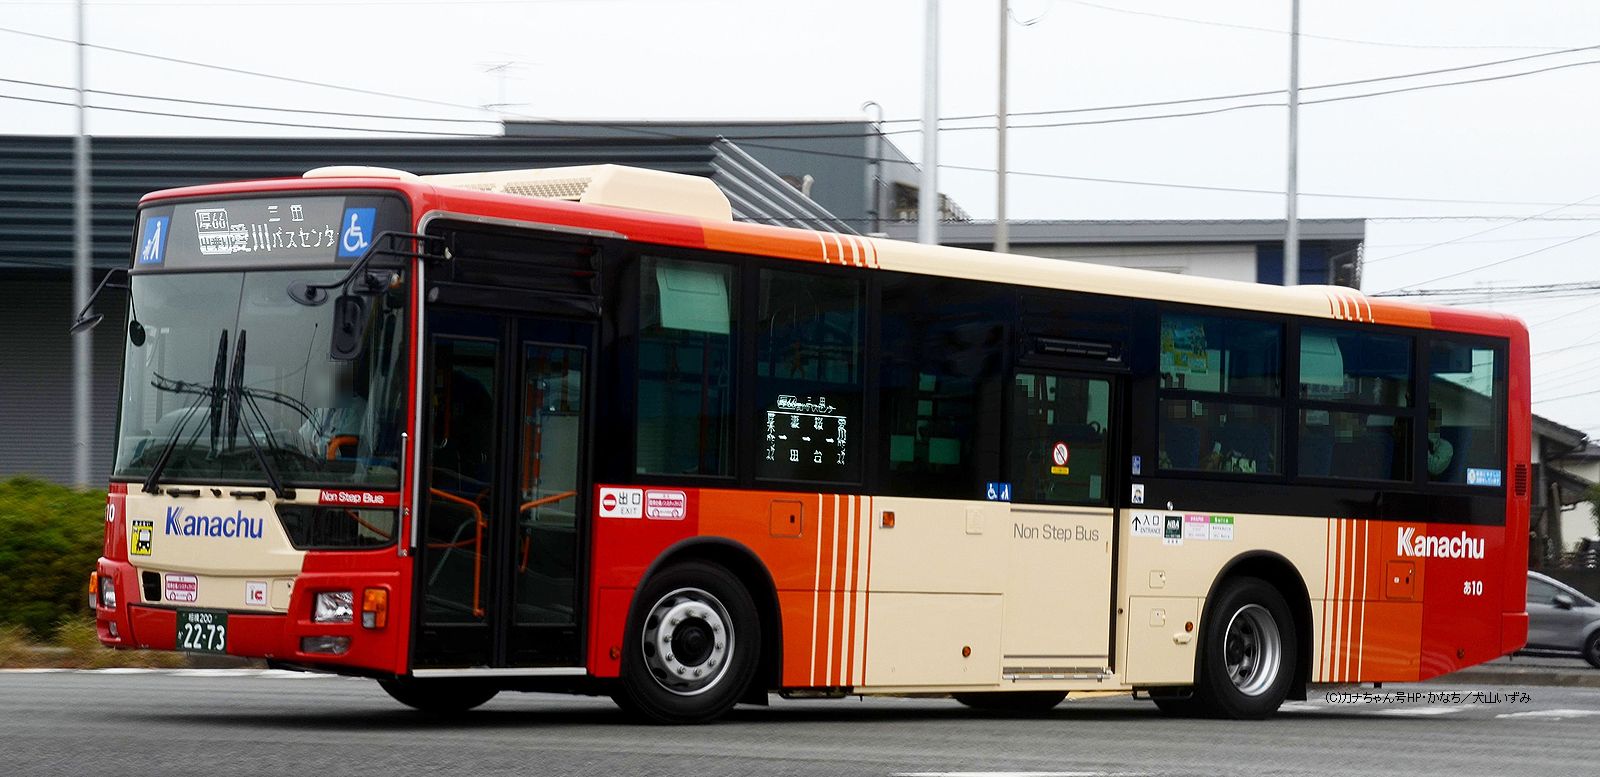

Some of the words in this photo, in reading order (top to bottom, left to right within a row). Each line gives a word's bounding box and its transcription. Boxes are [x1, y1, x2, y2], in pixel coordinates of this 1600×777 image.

[230, 223, 339, 252] 愛川バスセンタ
[321, 490, 338, 501] Non
[339, 491, 361, 503] Step
[363, 492, 384, 503] Bus
[618, 491, 641, 505] 出口
[620, 507, 637, 515] EXIT
[165, 506, 263, 539] Kanachu
[1142, 514, 1160, 526] 入口
[1013, 522, 1039, 539] Non
[1042, 523, 1072, 542] Step
[1075, 525, 1099, 541] Bus
[1397, 526, 1485, 559] Kanachu
[1463, 580, 1483, 596] あ10
